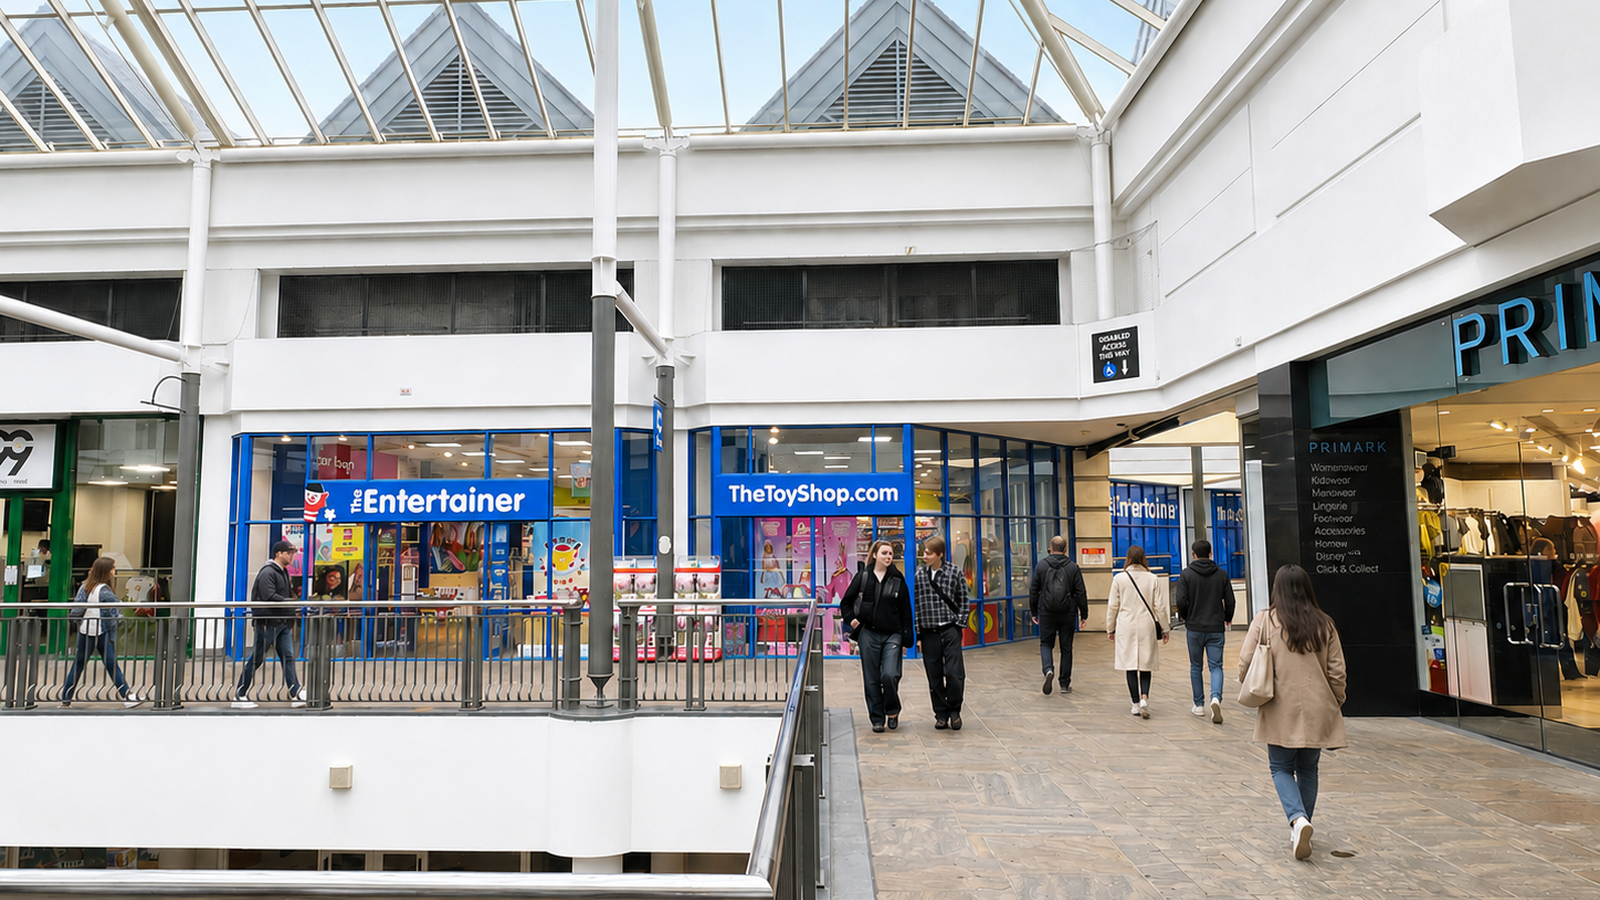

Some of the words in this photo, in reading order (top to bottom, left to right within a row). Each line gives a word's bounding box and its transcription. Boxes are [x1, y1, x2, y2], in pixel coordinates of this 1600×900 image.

[1308, 440, 1387, 454] PRIMARK
[349, 488, 363, 513] The
[364, 486, 526, 514] Entertainer
[728, 483, 899, 507] TheToyShop.com
[1312, 501, 1348, 512] Lingerie
[1316, 551, 1346, 562] Disney
[1316, 564, 1338, 574] Click
[1339, 564, 1347, 574] &
[1348, 563, 1379, 574] Collect
